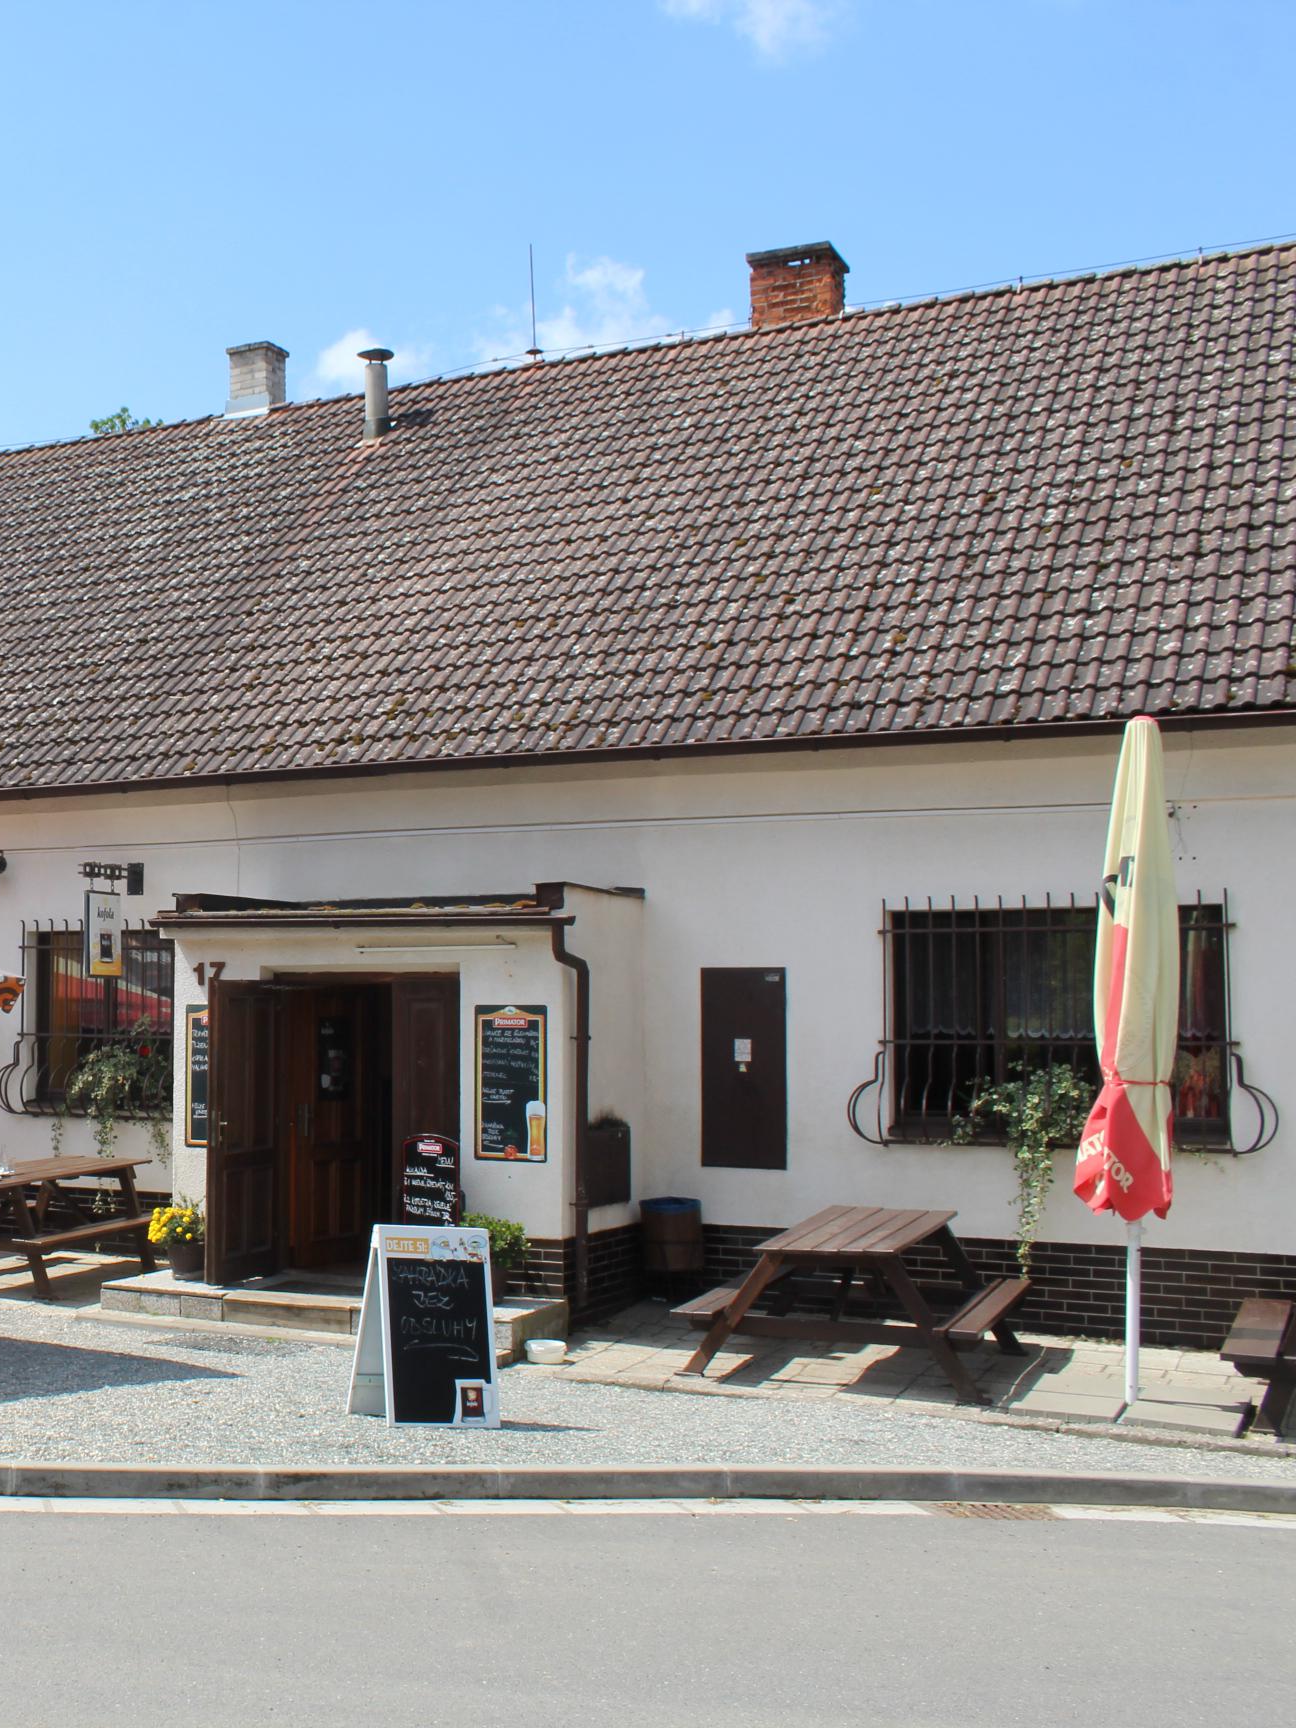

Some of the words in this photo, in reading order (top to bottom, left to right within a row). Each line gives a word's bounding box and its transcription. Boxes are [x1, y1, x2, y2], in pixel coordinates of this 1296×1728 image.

[96, 906, 115, 921] kofola
[193, 962, 226, 986] 17
[495, 1017, 526, 1026] PRIMATOR
[387, 1240, 415, 1251] DEJTE
[417, 1241, 428, 1252] SI:
